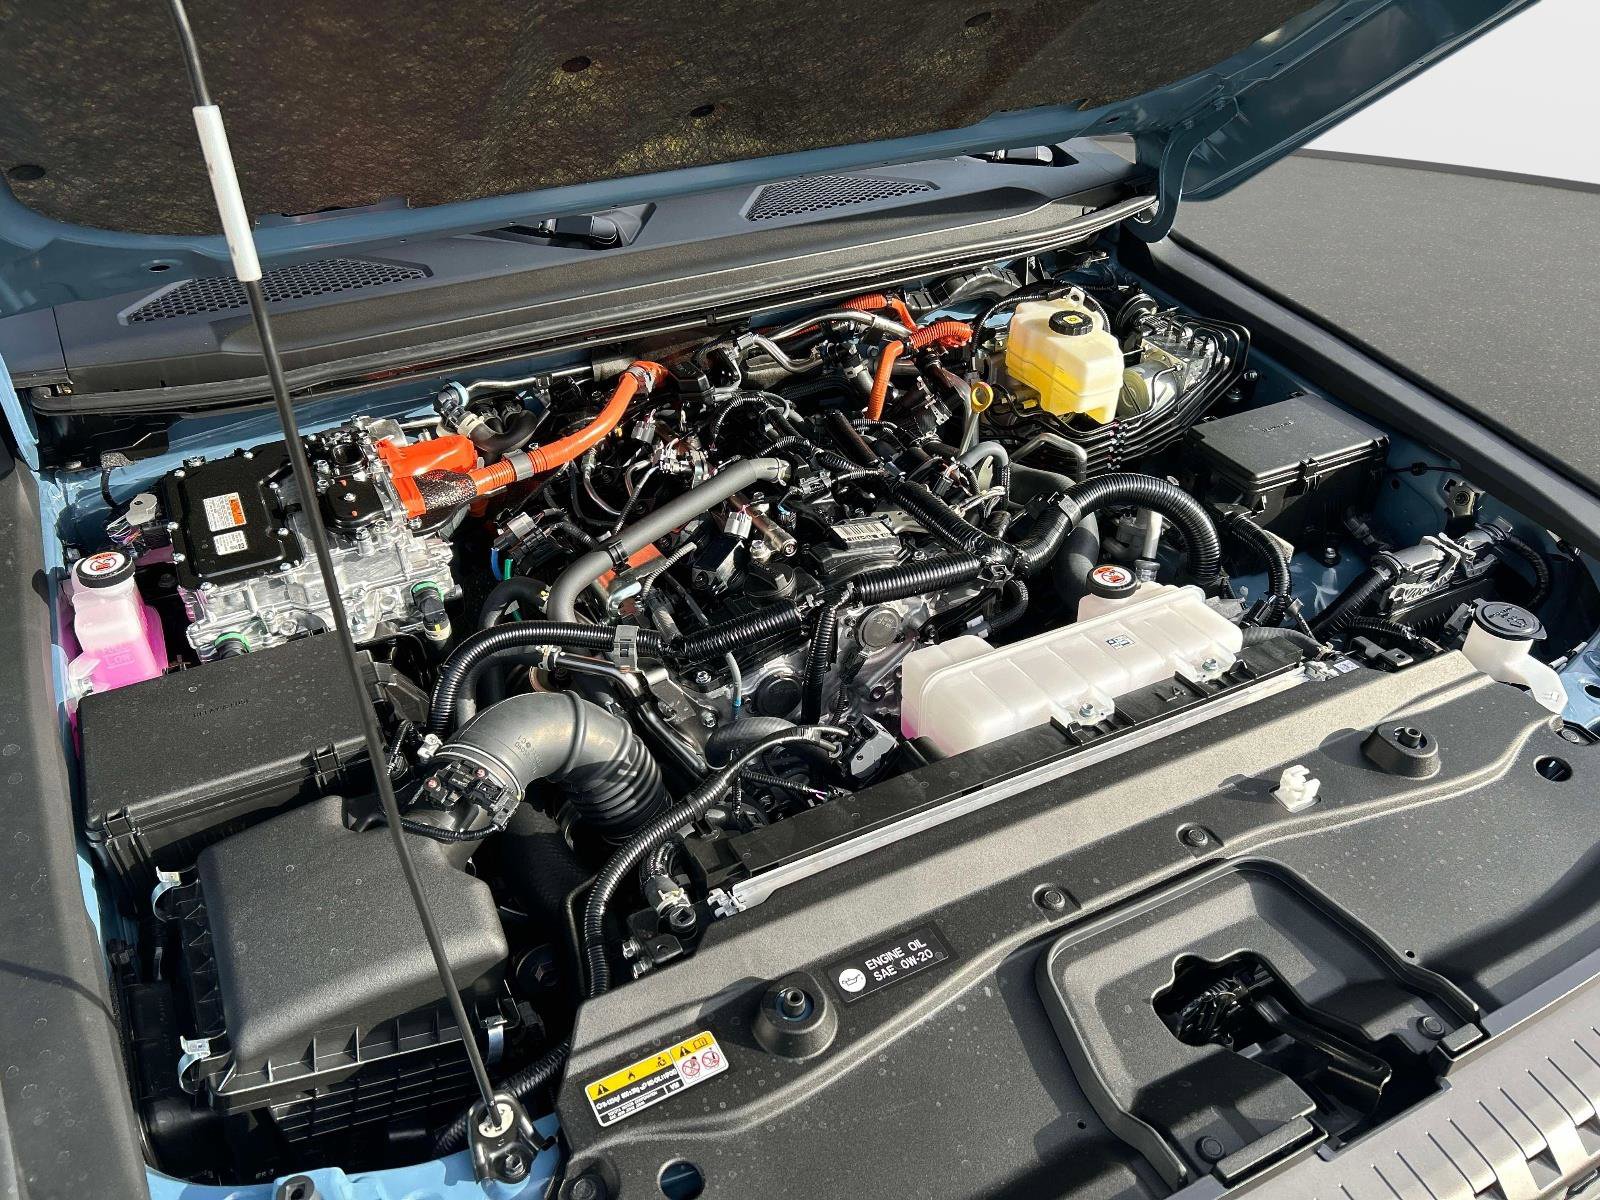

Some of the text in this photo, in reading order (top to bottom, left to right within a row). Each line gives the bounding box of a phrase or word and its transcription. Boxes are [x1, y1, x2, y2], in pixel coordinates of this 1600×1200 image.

[865, 939, 927, 970] ENGINE OIL
[873, 949, 934, 981] SAE 0W-20
